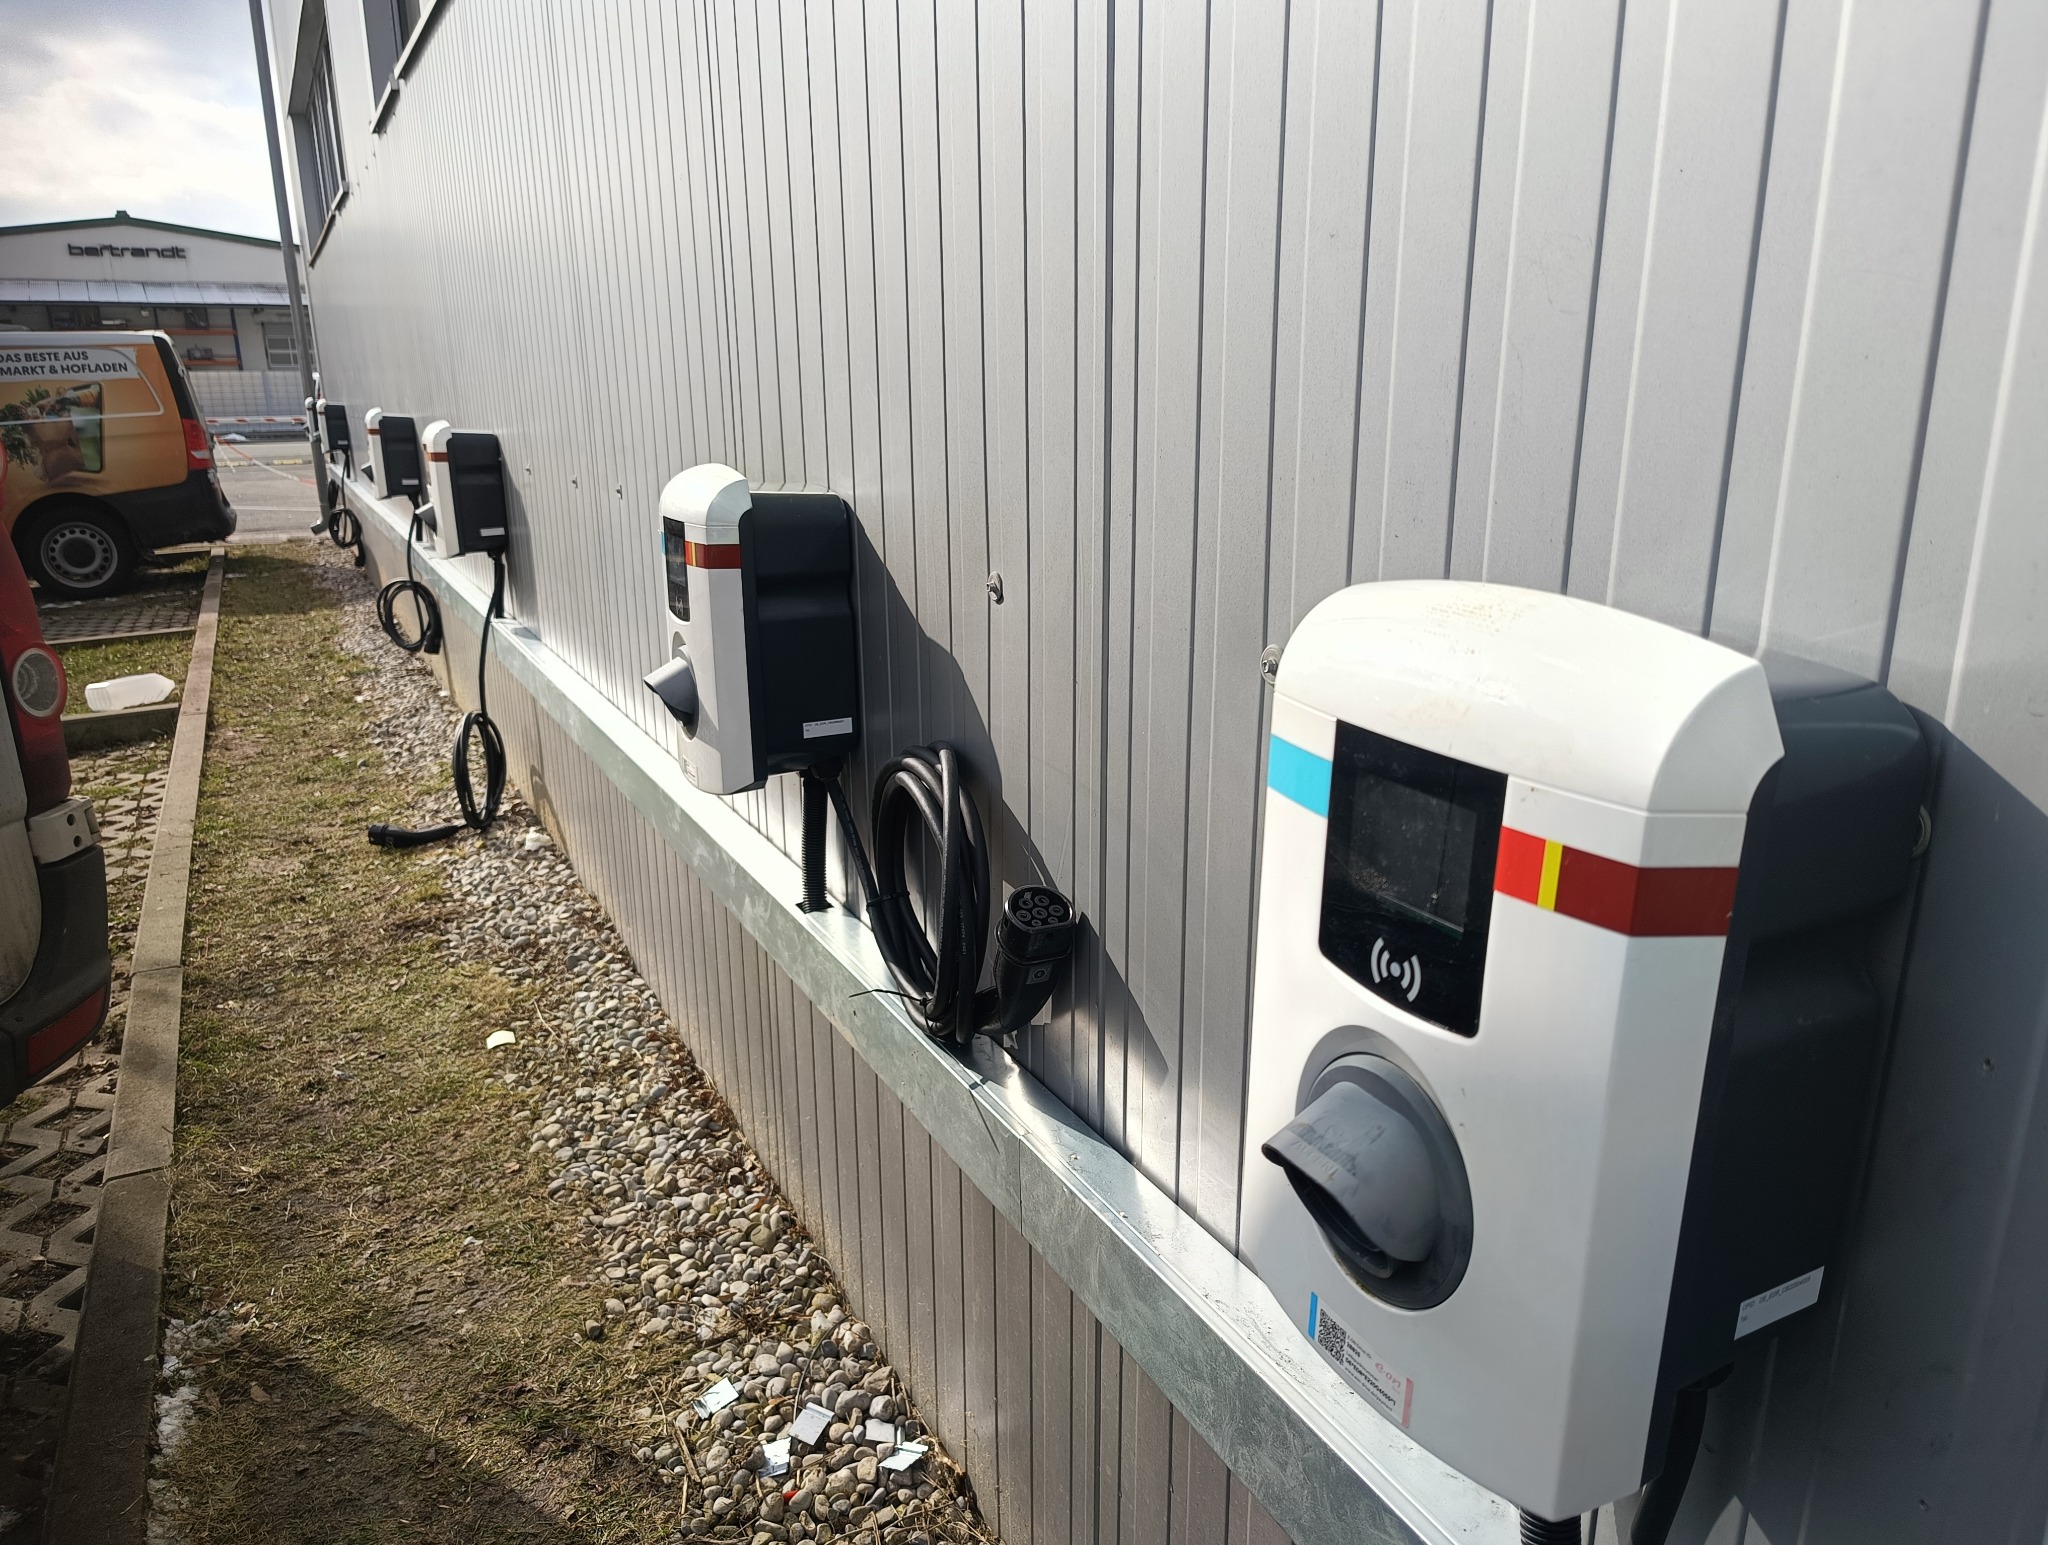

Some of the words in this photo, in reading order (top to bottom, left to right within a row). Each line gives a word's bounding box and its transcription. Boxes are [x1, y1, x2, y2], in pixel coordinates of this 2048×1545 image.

[68, 243, 187, 259] bertrandt
[24, 352, 61, 363] BESTE
[63, 351, 89, 361] AUS
[0, 365, 46, 377] MARKT
[49, 364, 58, 375] &
[60, 362, 128, 374] HOFLADEN
